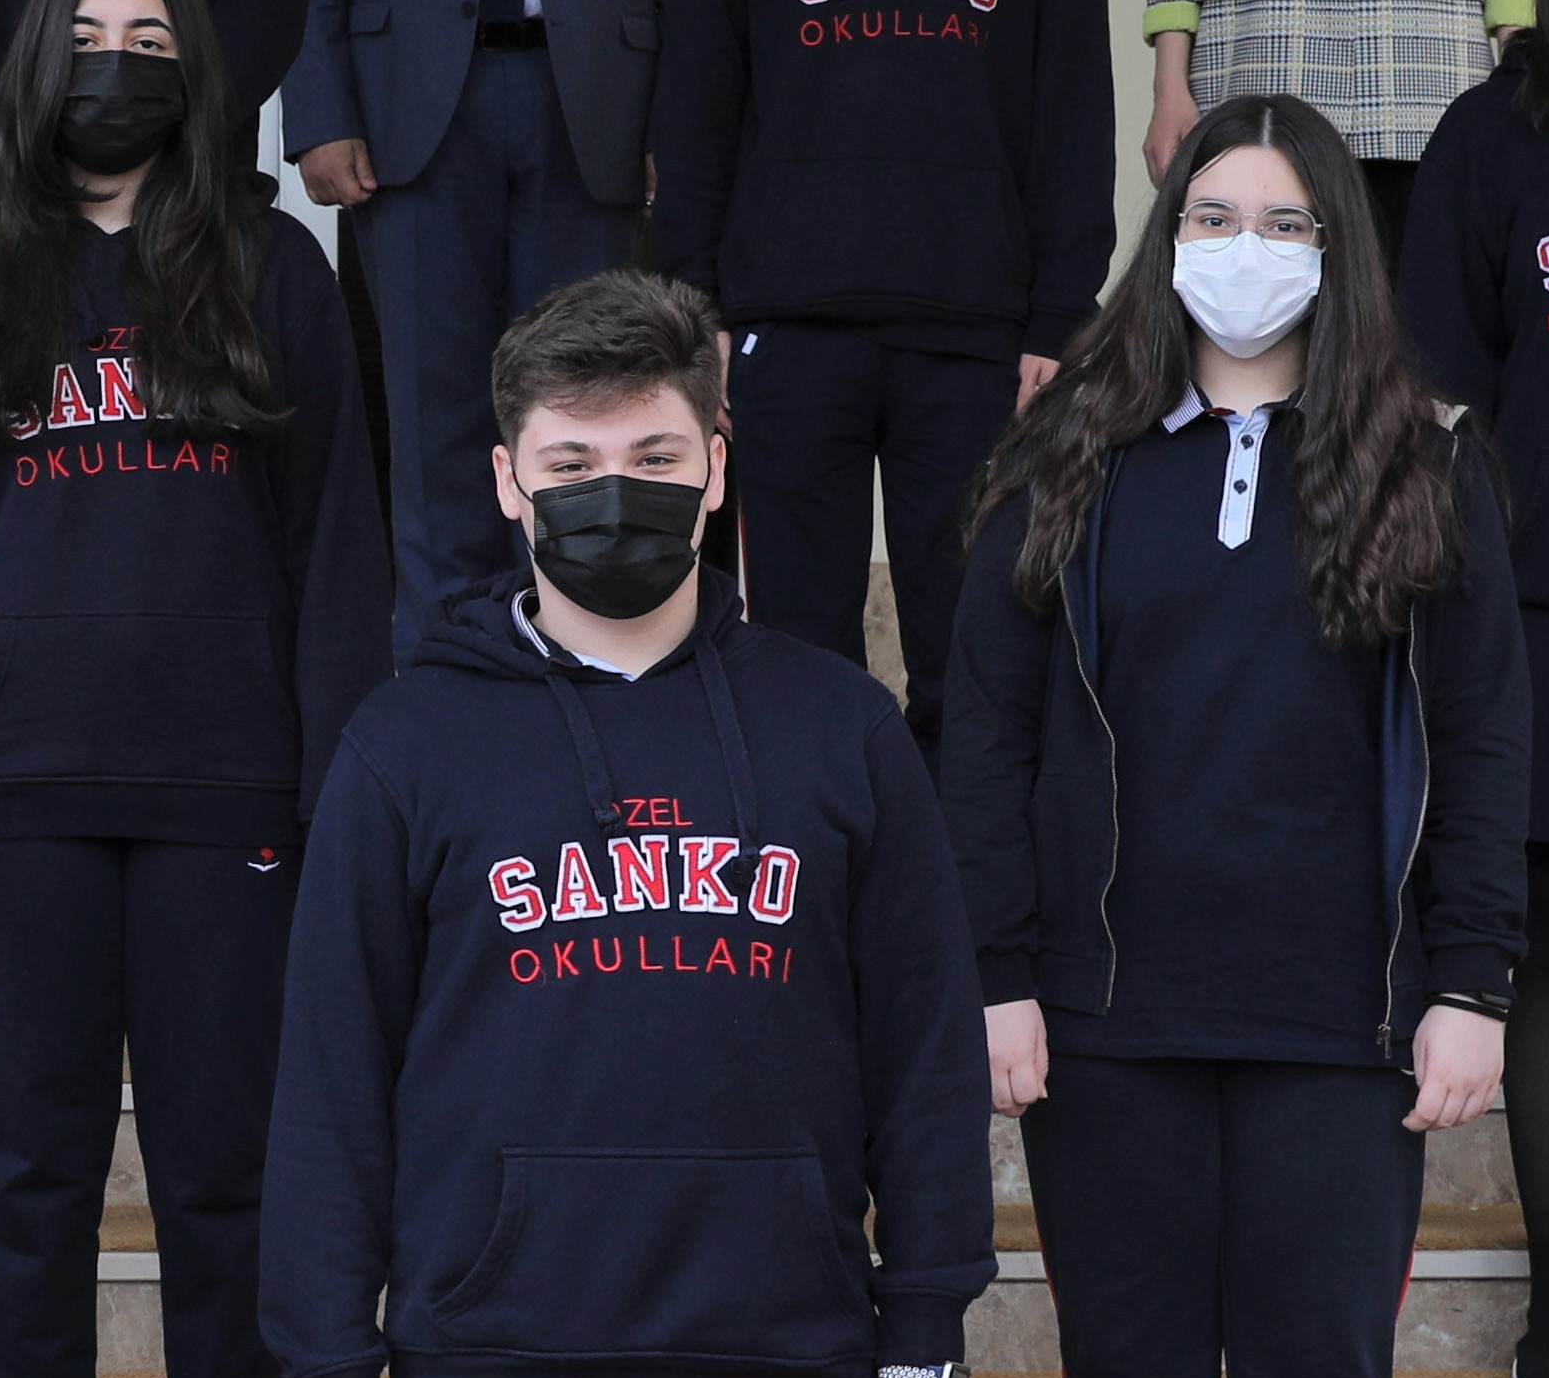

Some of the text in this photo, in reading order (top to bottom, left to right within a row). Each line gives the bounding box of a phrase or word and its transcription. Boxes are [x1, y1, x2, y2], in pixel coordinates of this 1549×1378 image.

[800, 9, 990, 52] OKULLARI
[16, 439, 239, 487] OKULLARI
[488, 834, 800, 934] SANKO
[510, 935, 793, 984] OKULLARI
